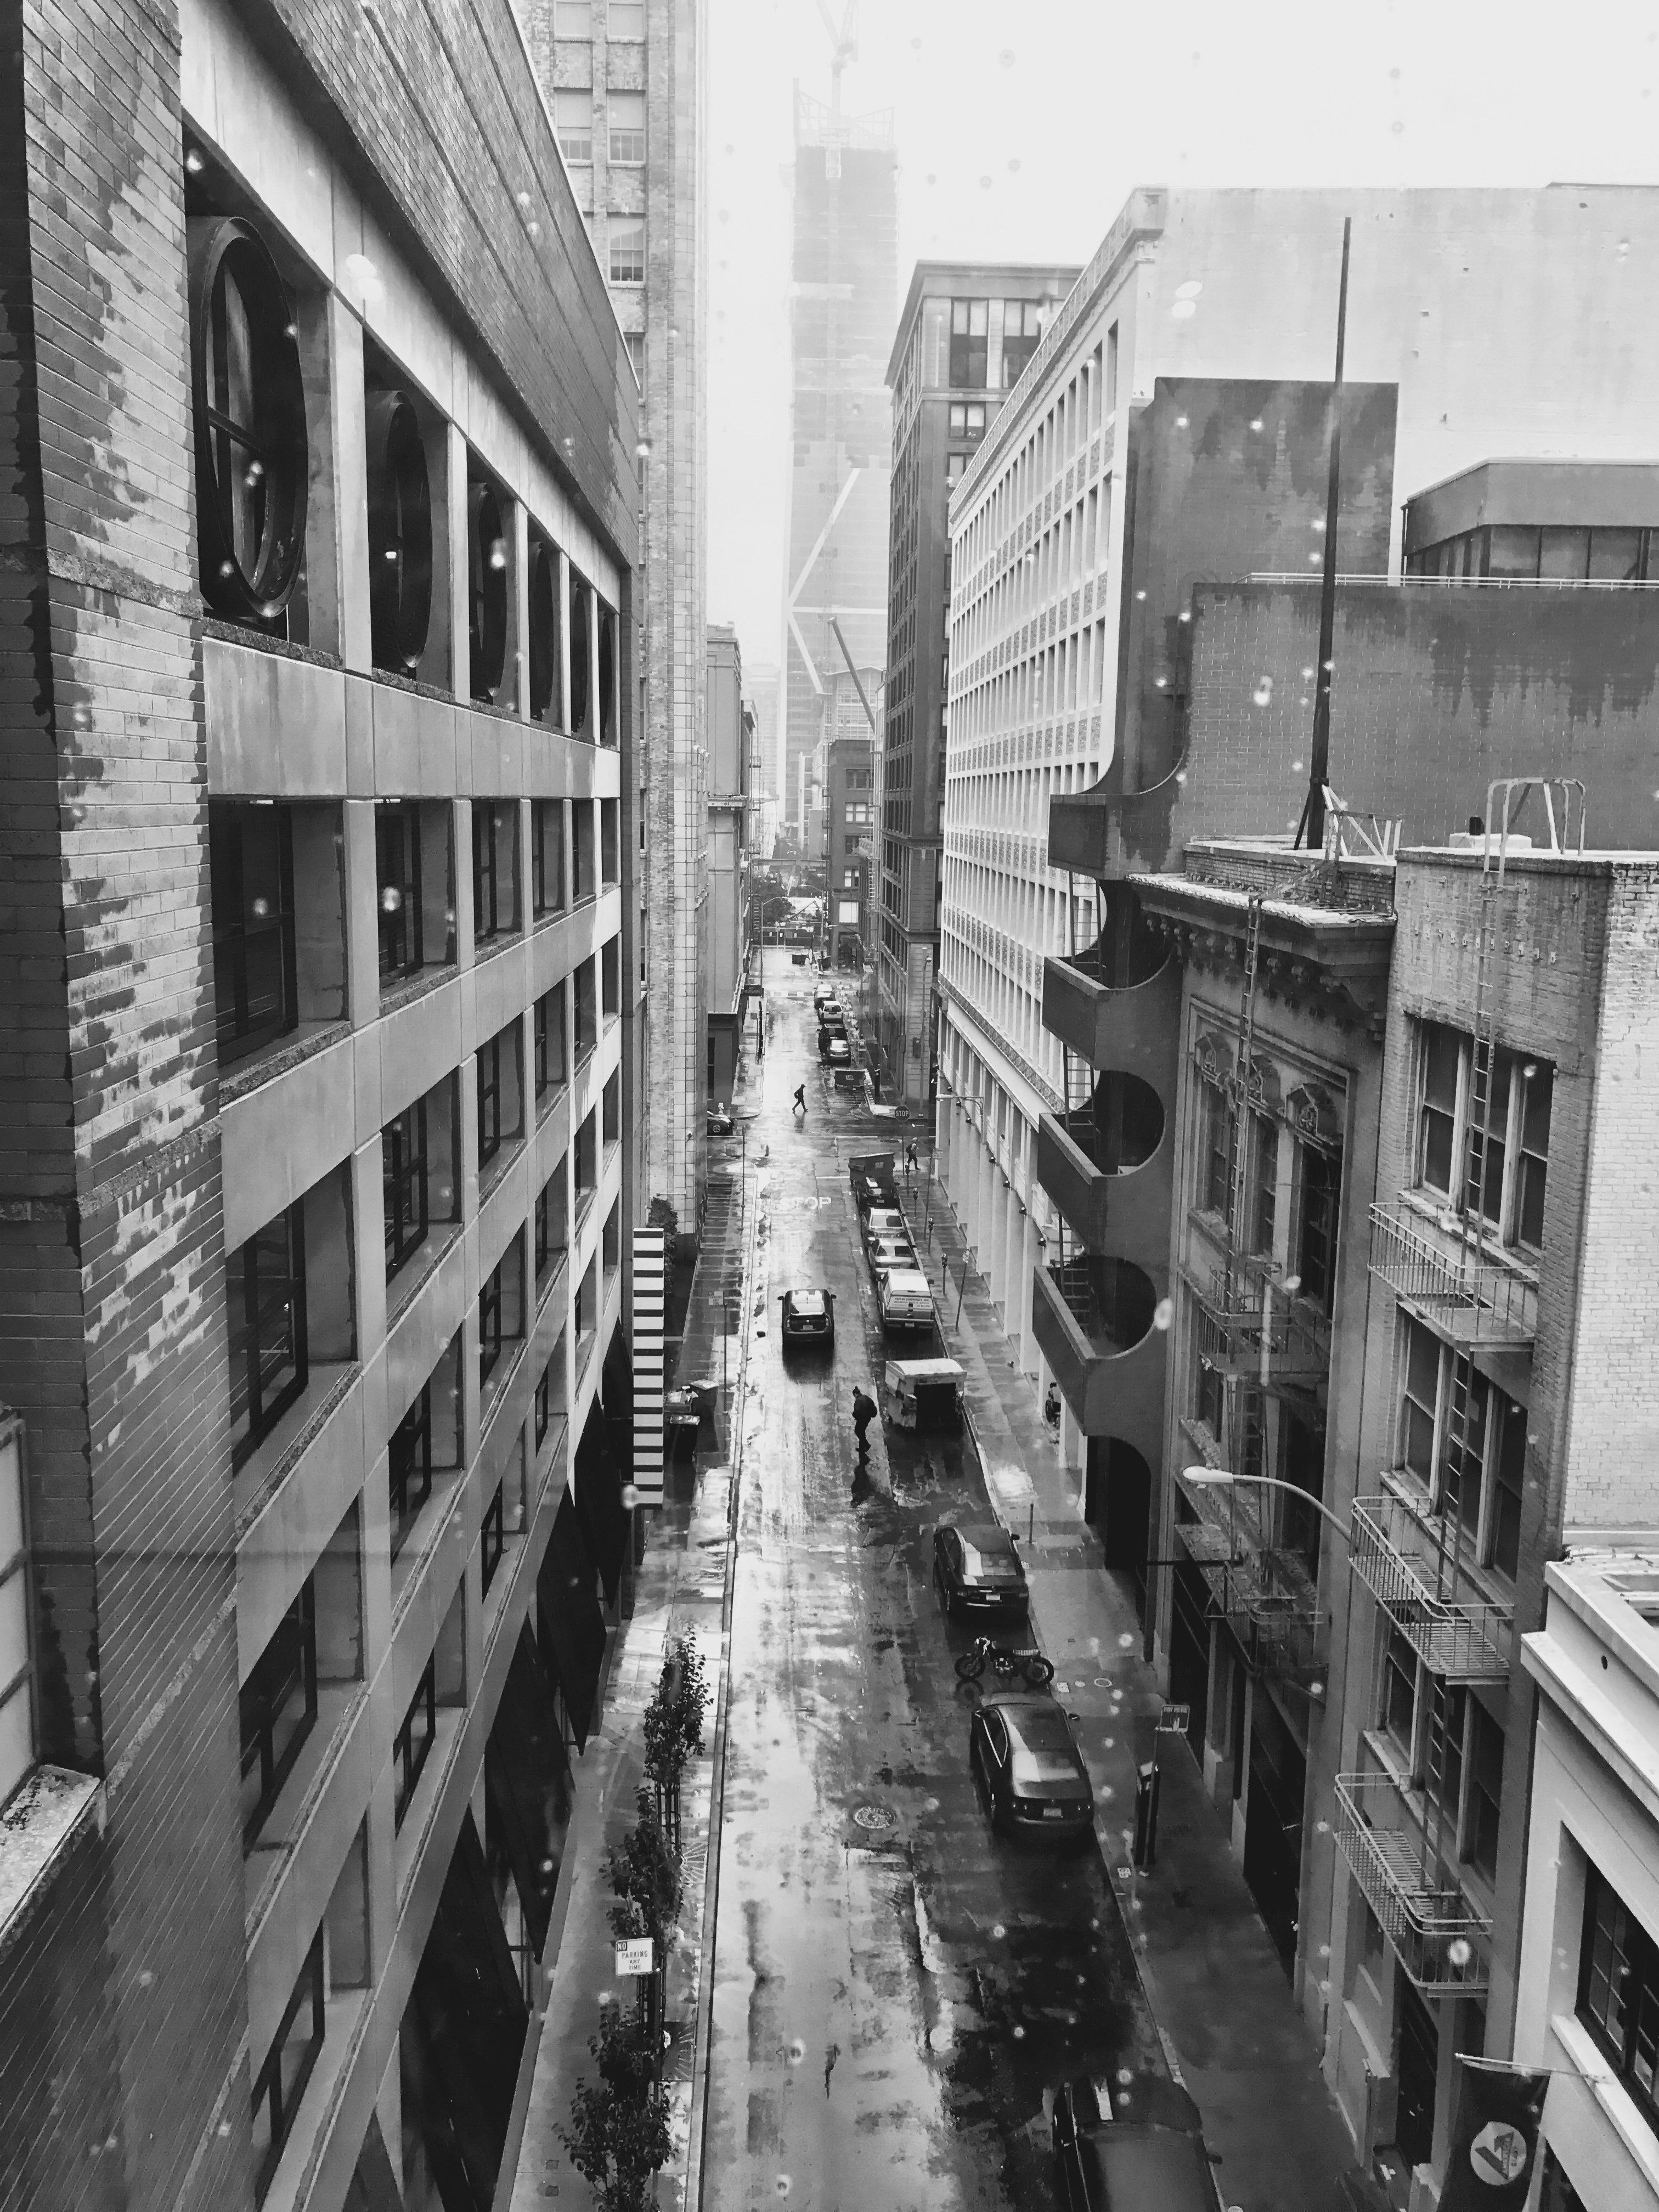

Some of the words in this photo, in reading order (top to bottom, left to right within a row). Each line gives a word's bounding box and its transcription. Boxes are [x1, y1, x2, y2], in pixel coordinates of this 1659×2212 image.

[778, 1195, 832, 1210] STOP
[617, 1942, 627, 1950] NO
[622, 1950, 648, 1959] PARKING
